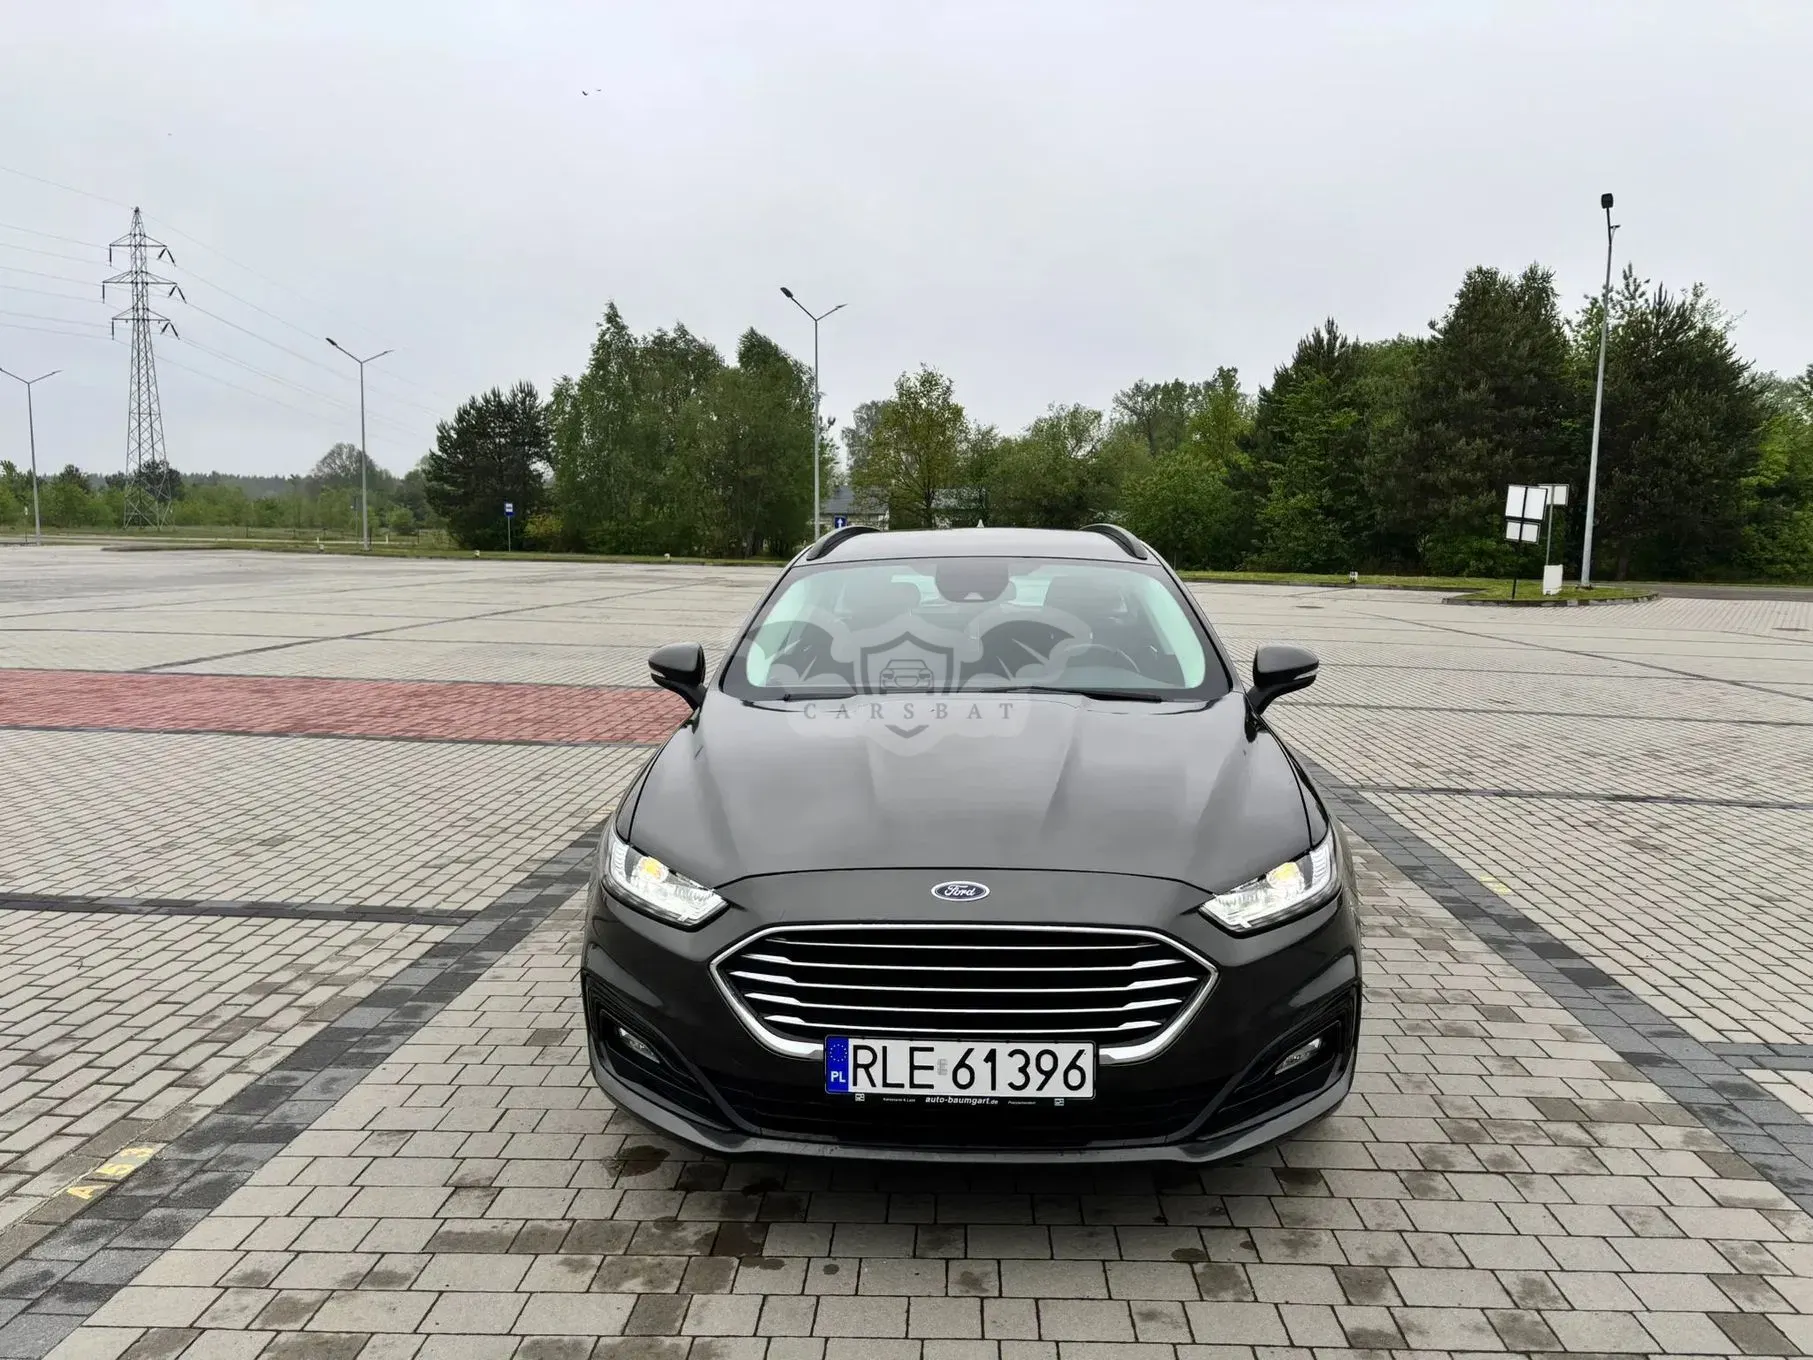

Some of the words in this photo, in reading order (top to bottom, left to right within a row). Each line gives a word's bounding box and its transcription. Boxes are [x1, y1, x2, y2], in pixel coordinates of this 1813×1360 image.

[944, 884, 976, 896] Ford
[852, 1044, 934, 1089] RLE
[952, 1048, 1086, 1092] 61396
[830, 1071, 846, 1083] PL
[925, 1096, 999, 1106] auto-baumgart.de
